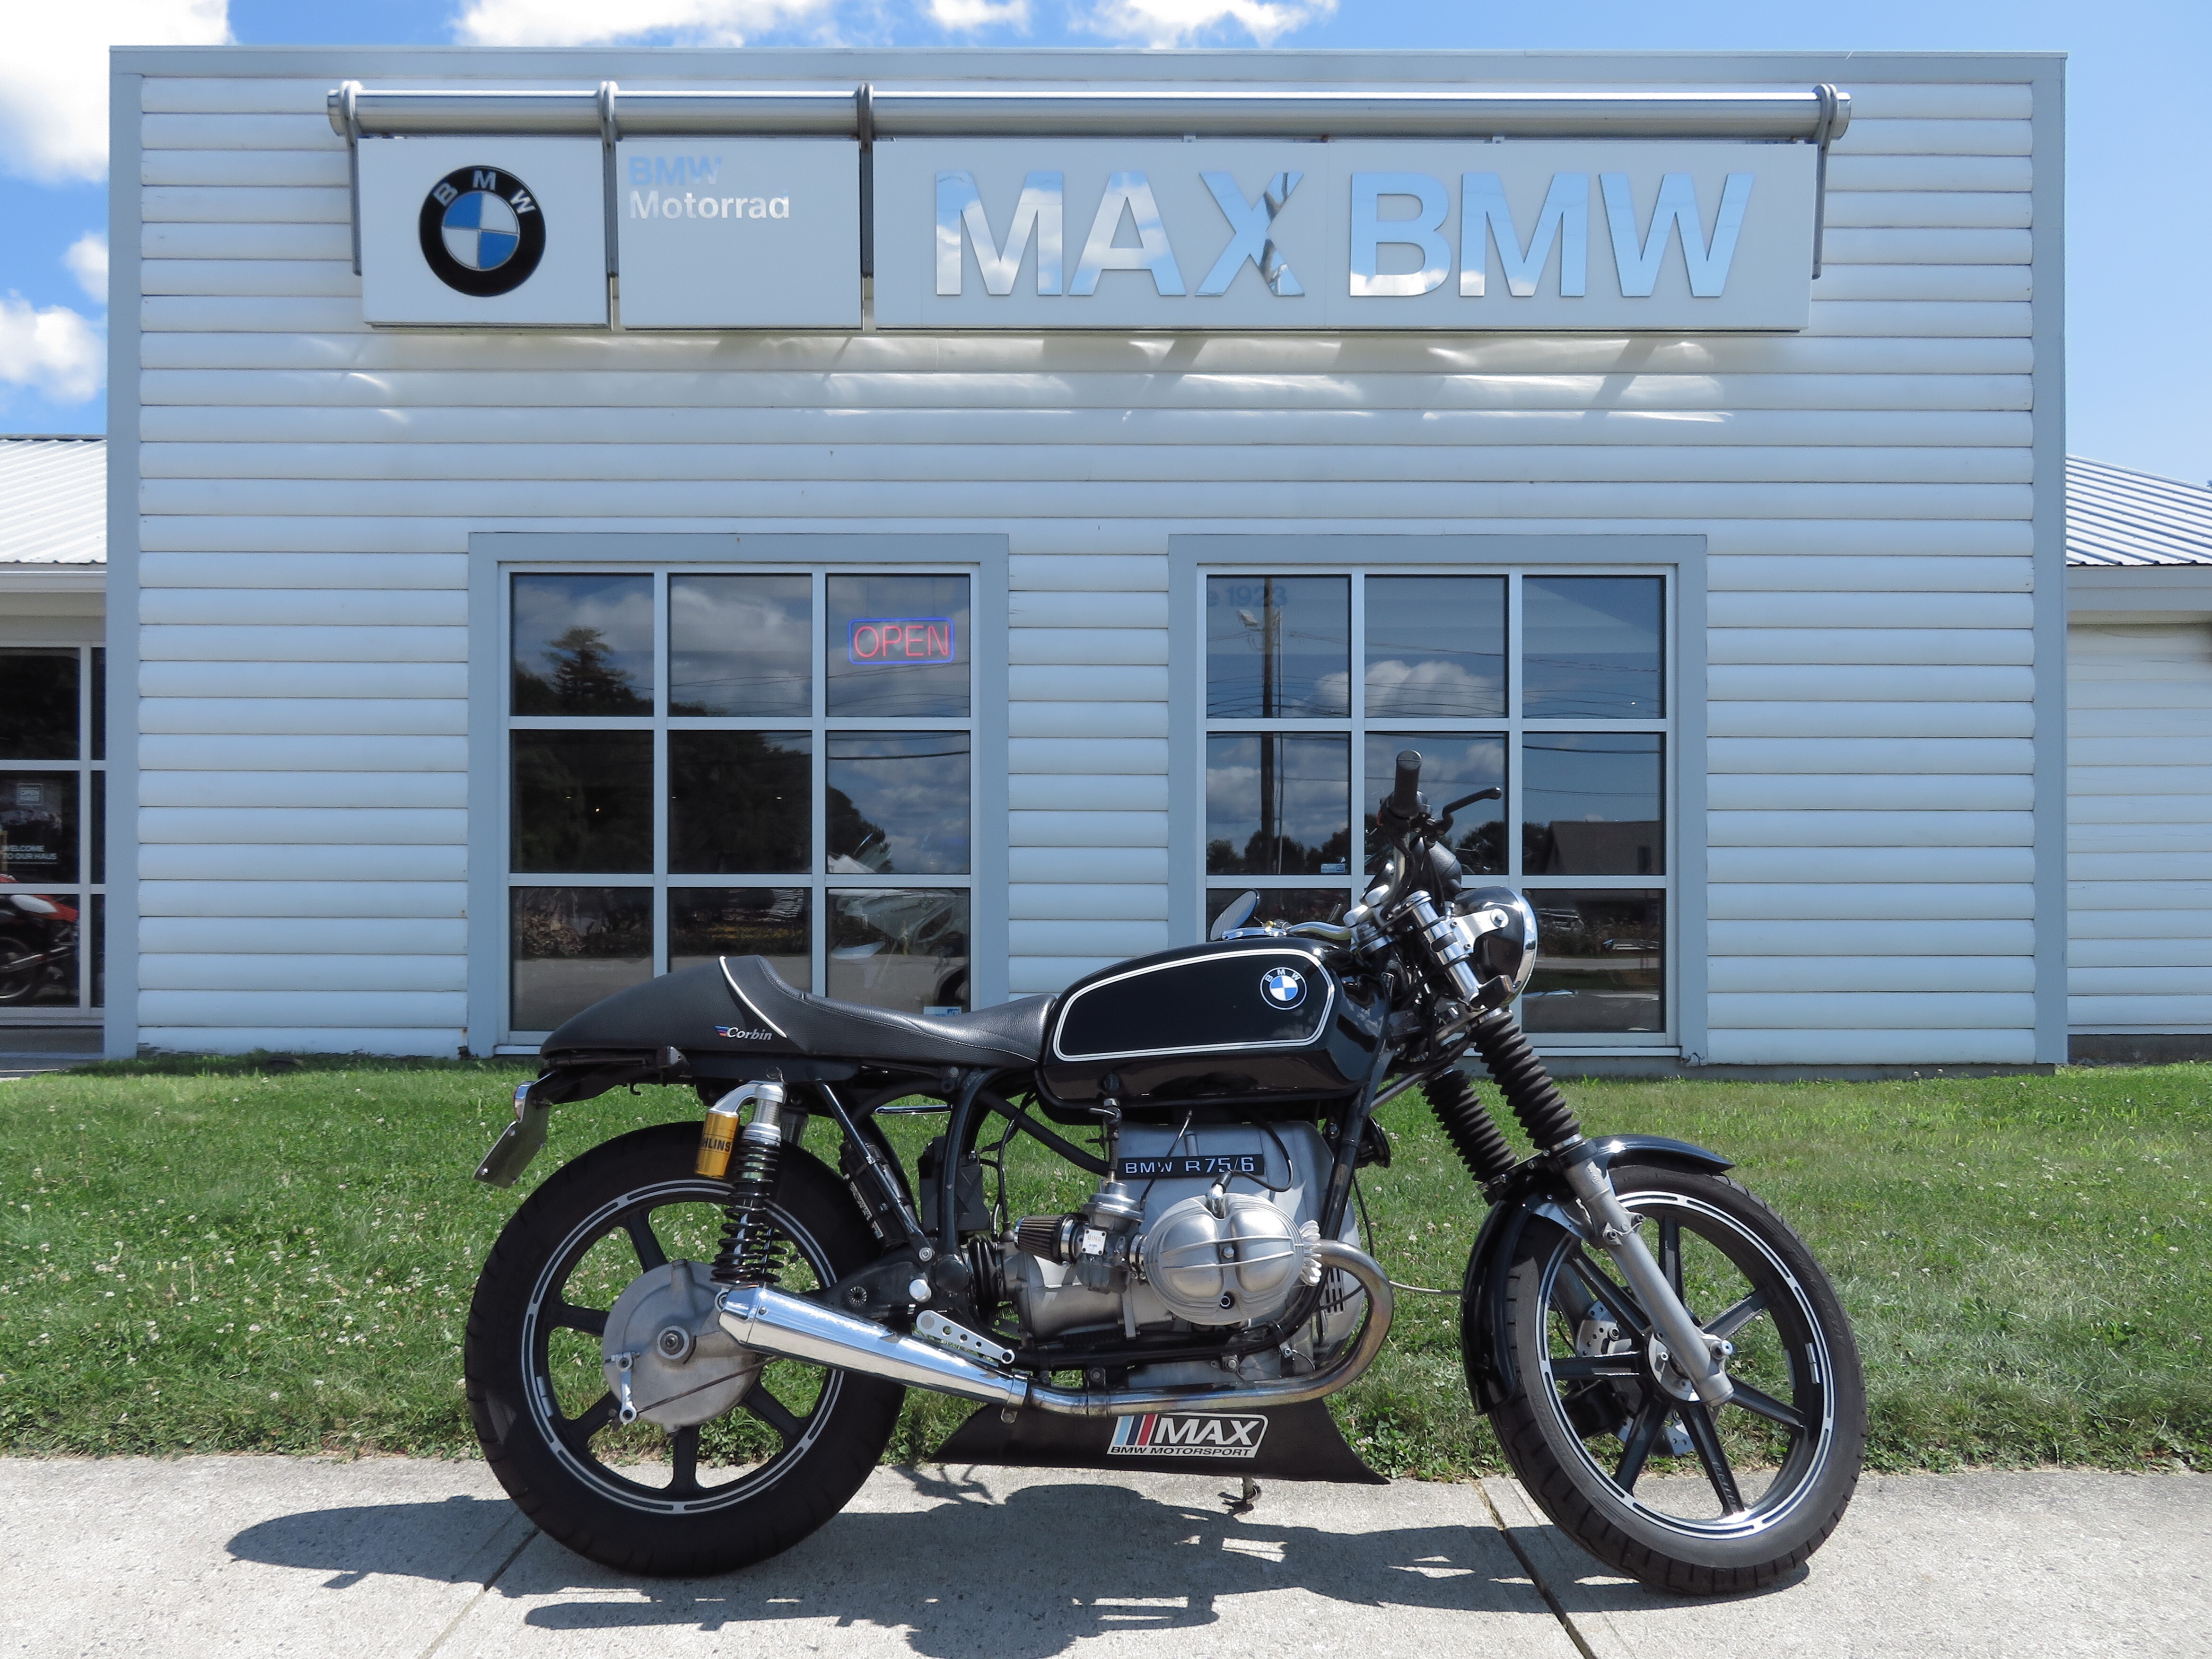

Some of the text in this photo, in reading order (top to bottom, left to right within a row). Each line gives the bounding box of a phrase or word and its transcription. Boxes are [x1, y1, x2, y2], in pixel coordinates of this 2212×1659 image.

[629, 156, 722, 185] BMW
[434, 171, 535, 214] BMW
[630, 190, 790, 219] Motorrad
[935, 171, 1755, 297] MAX BMW
[854, 625, 949, 658] OPEN
[1265, 969, 1301, 982] BMW
[726, 1027, 772, 1040] Corbin
[1125, 1161, 1172, 1174] BMW
[1154, 1417, 1260, 1446] MAX
[1110, 1446, 1252, 1457] BMW MOTORSPORT
